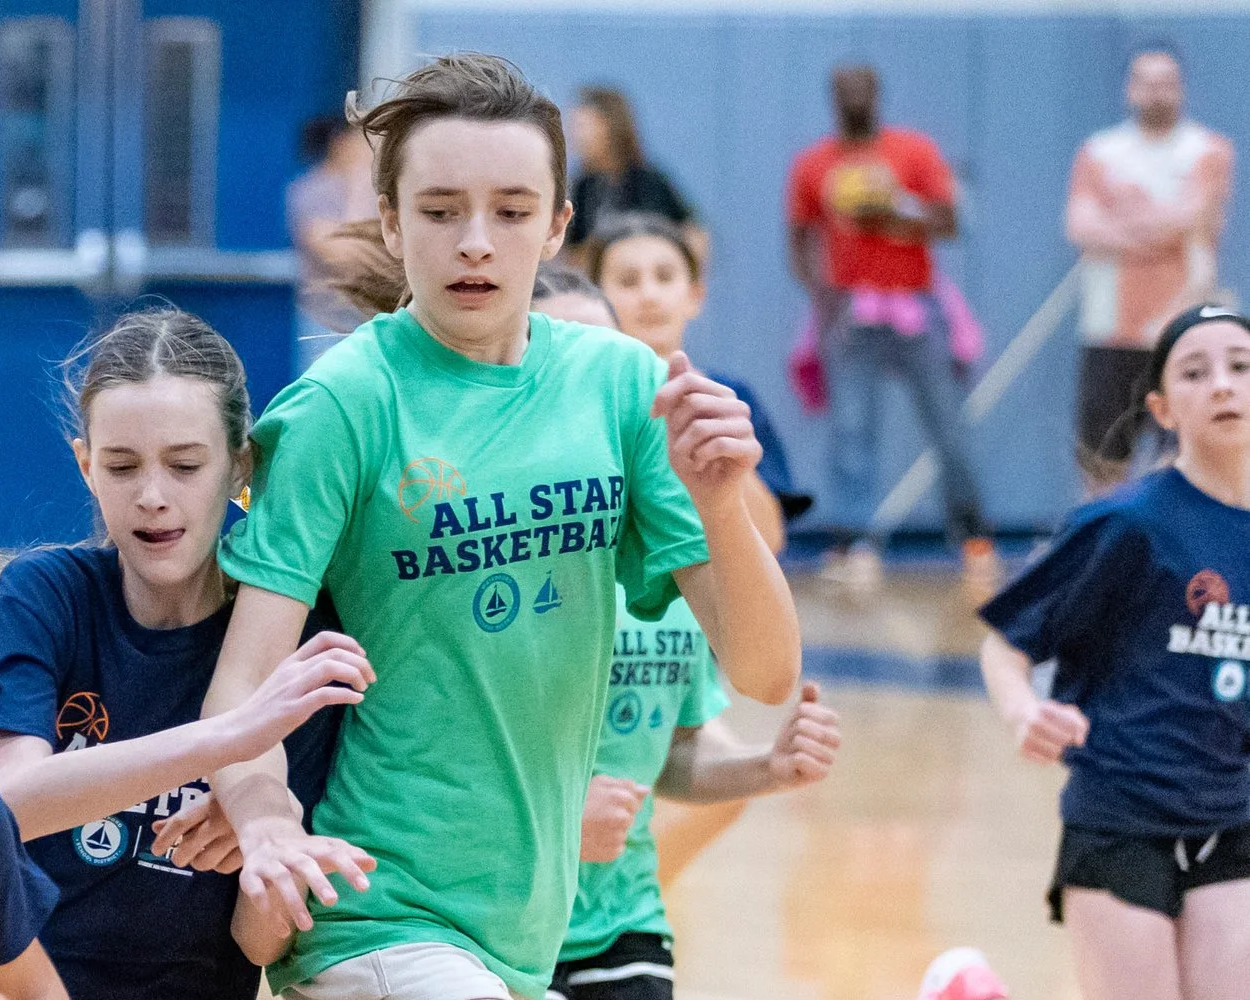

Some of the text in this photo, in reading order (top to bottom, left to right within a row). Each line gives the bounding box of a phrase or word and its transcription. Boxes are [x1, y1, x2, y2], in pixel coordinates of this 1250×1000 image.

[430, 475, 625, 539] ALL STAR
[391, 514, 623, 581] BASKETBA
[613, 631, 647, 656] LL
